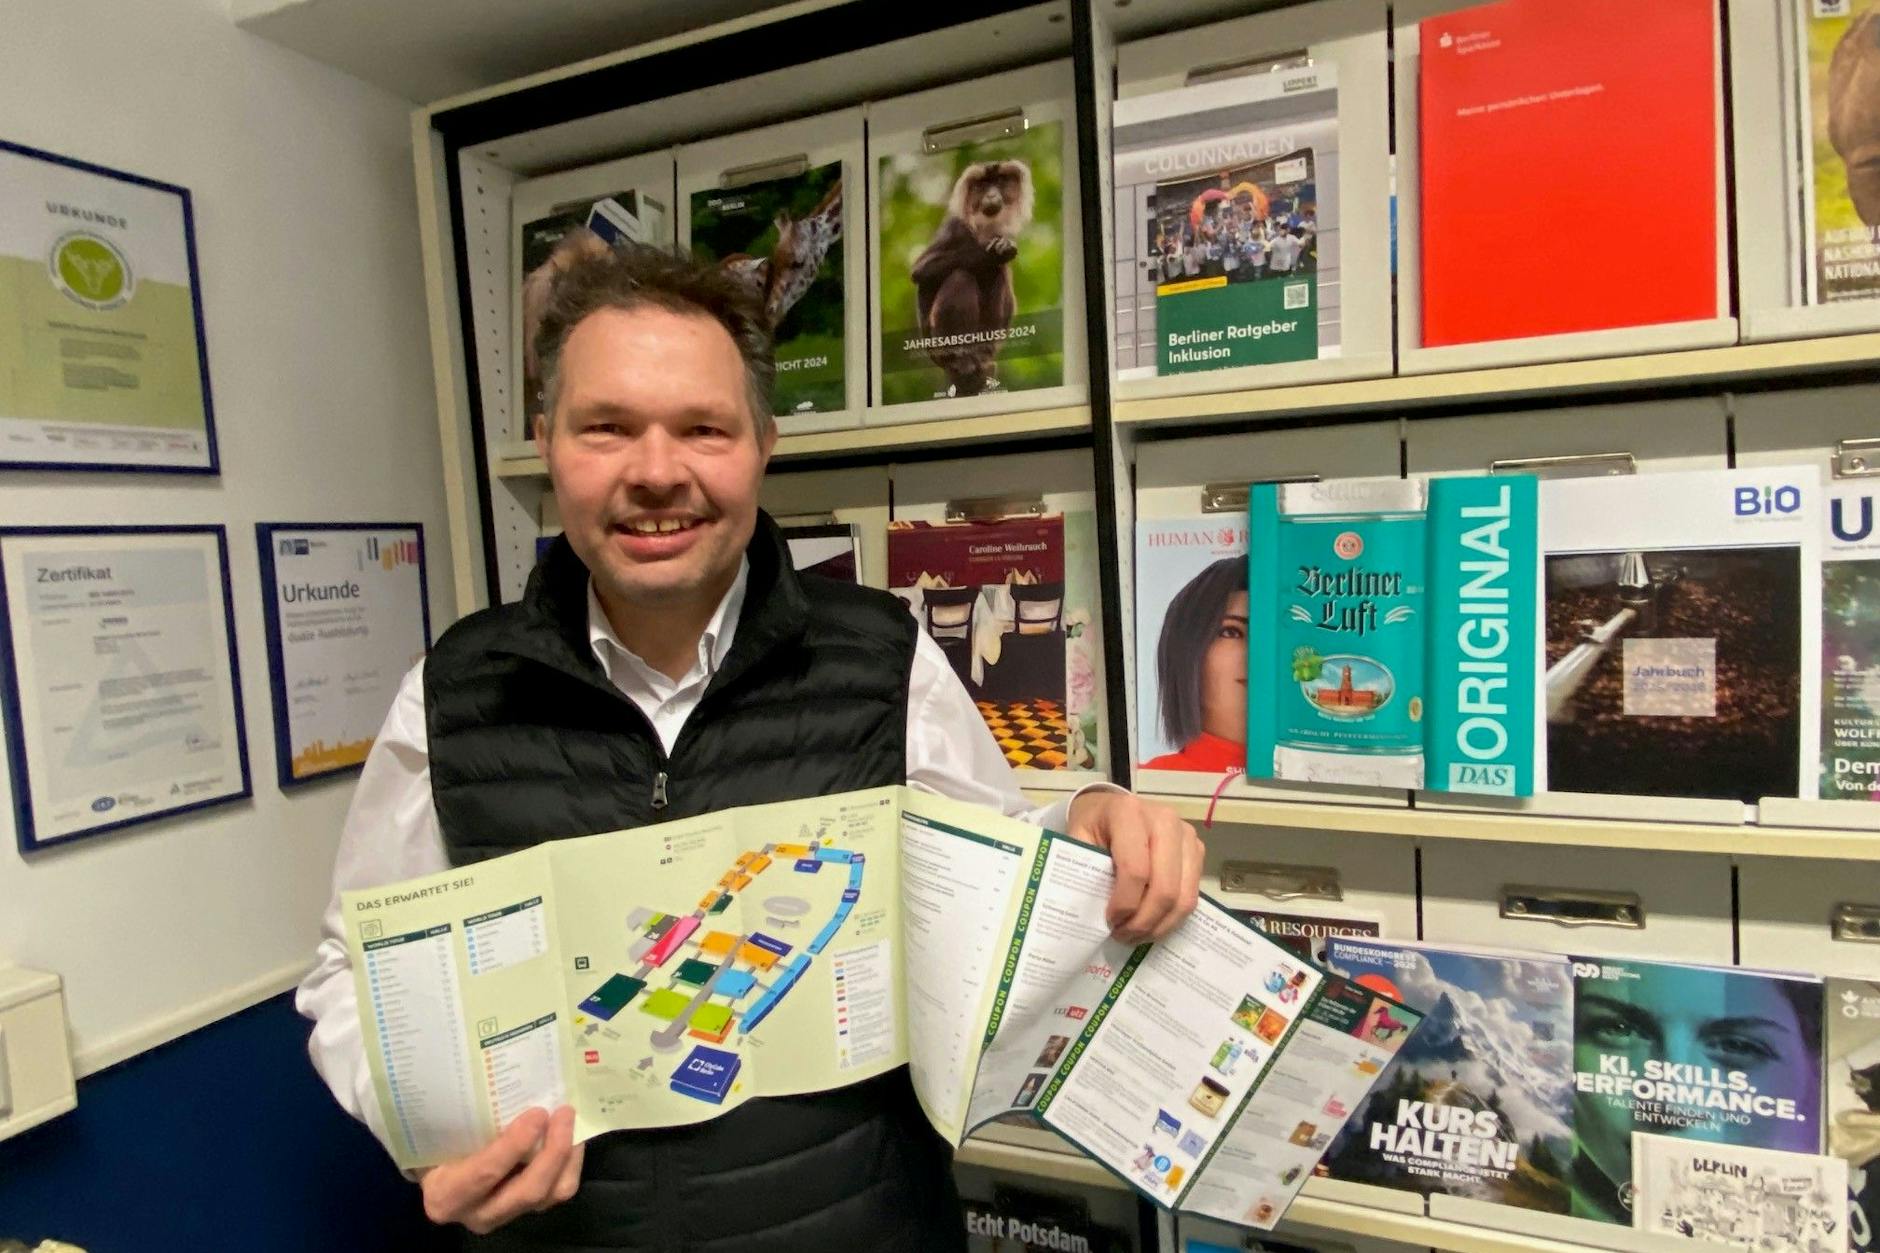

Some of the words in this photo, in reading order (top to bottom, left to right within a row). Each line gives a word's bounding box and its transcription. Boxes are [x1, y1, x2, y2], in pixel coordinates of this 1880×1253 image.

[1145, 134, 1296, 175] COLONNADEN
[45, 200, 128, 229] URKUNDE
[903, 329, 1007, 350] JAHRESABSCHLUSS
[1009, 325, 1036, 339] 2024
[1168, 330, 1223, 347] Berliner
[1227, 320, 1298, 340] Ratgeber
[804, 356, 828, 368] 2024
[1168, 346, 1231, 364] Inklusion
[968, 545, 1003, 555] Caroline
[1004, 541, 1048, 553] Weihrauch
[1149, 531, 1213, 547] HUMAN
[37, 566, 112, 584] Zertifikat
[1297, 565, 1402, 598] Berliner
[282, 580, 360, 603] Urkunde
[1315, 600, 1378, 637] Luft
[1456, 484, 1512, 760] ORIGINAL
[1632, 665, 1705, 678] Jahrbuch
[1834, 728, 1880, 739] WOLF
[1457, 765, 1509, 786] DAS
[1835, 780, 1863, 791] Von
[1031, 838, 1050, 882] COUPON
[356, 898, 382, 912] DAS
[384, 884, 450, 906] ERWARTET
[453, 877, 475, 890] SIE!
[1018, 887, 1036, 932] COUPON
[1003, 939, 1022, 984] COUPON
[1333, 951, 1383, 966] COMPLIANCE
[987, 988, 1006, 1036] COUPON
[1084, 1002, 1110, 1038] COUPON
[1060, 1041, 1086, 1076] COUPON
[1600, 1054, 1637, 1077] KI.
[1644, 1059, 1757, 1094] SKILLS.
[1036, 1079, 1062, 1114] COUPON
[1573, 1072, 1806, 1122] ERFORMANCE.
[1396, 1098, 1498, 1140] KURS
[1607, 1096, 1662, 1115] TALENTE
[1665, 1101, 1715, 1120] FINDEN
[1719, 1111, 1751, 1126] UND
[1634, 1111, 1721, 1133] ENTWICKELN
[1369, 1122, 1520, 1170] HALTEN!
[1382, 1152, 1406, 1164] WAS
[1407, 1157, 1478, 1175] COMPLIANCE
[1407, 1166, 1441, 1178] STARK
[1693, 1157, 1748, 1178] BERLIN
[966, 1211, 1005, 1238] Echt
